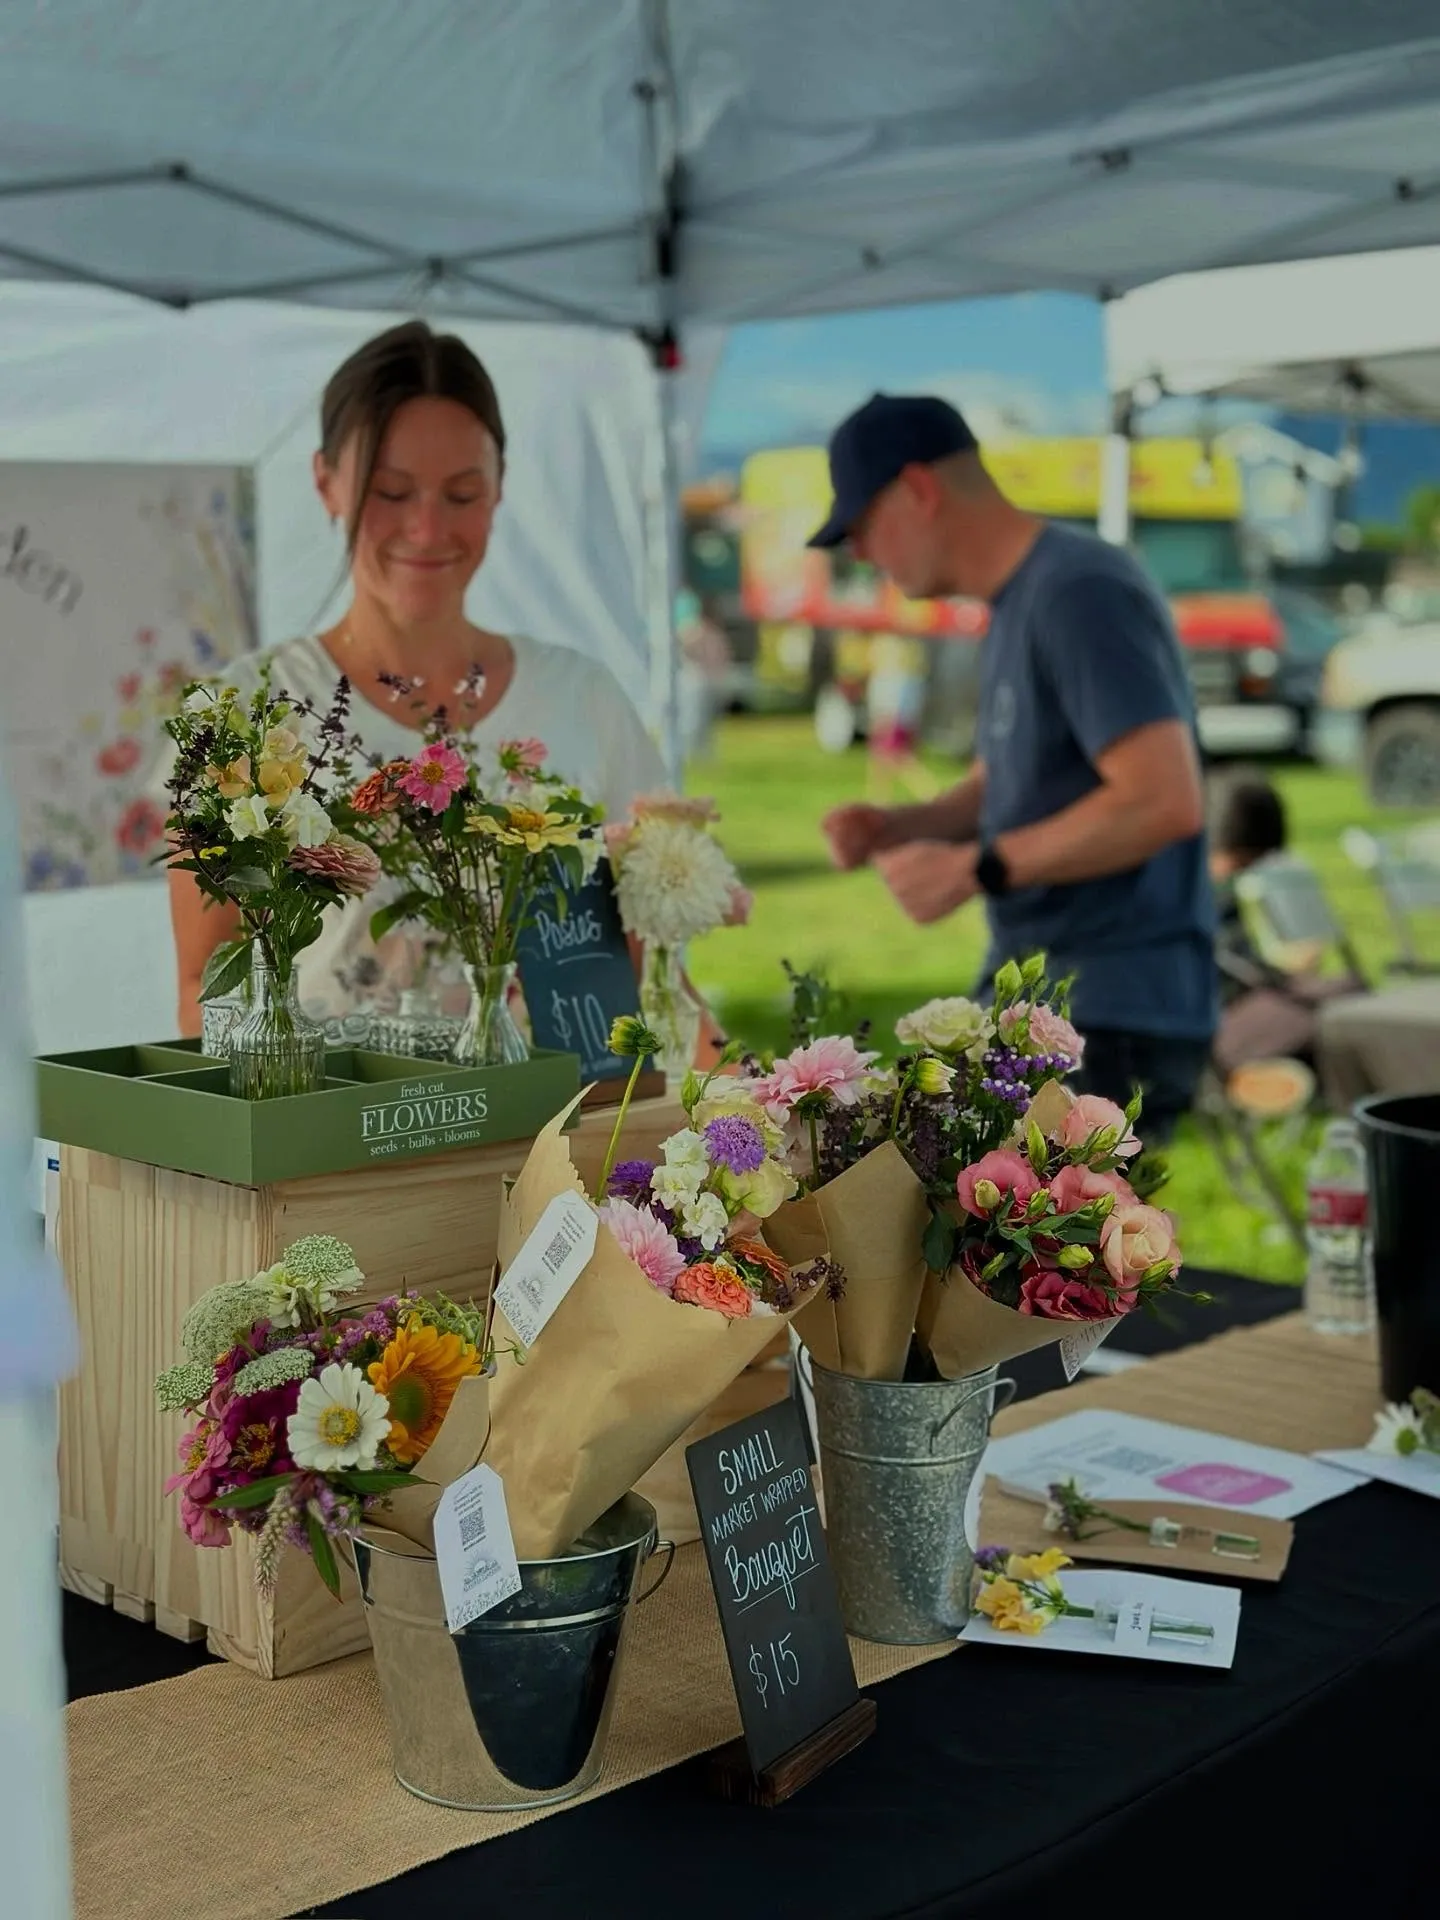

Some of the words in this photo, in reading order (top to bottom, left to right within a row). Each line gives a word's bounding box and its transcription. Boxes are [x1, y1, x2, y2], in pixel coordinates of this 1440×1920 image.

[535, 909, 602, 958] Posies
[551, 990, 609, 1061] $10
[361, 1093, 487, 1137] FLOWERS
[401, 1082, 425, 1098] fresh
[428, 1082, 444, 1095] cut
[370, 1140, 398, 1156] seeds
[409, 1136, 436, 1149] bulbs
[445, 1129, 481, 1143] blooms
[718, 1429, 785, 1495] SMALL
[711, 1493, 758, 1545] MARKET
[760, 1468, 807, 1513] WRAPPED
[725, 1505, 816, 1610] Bouquet
[750, 1633, 800, 1709] $15
